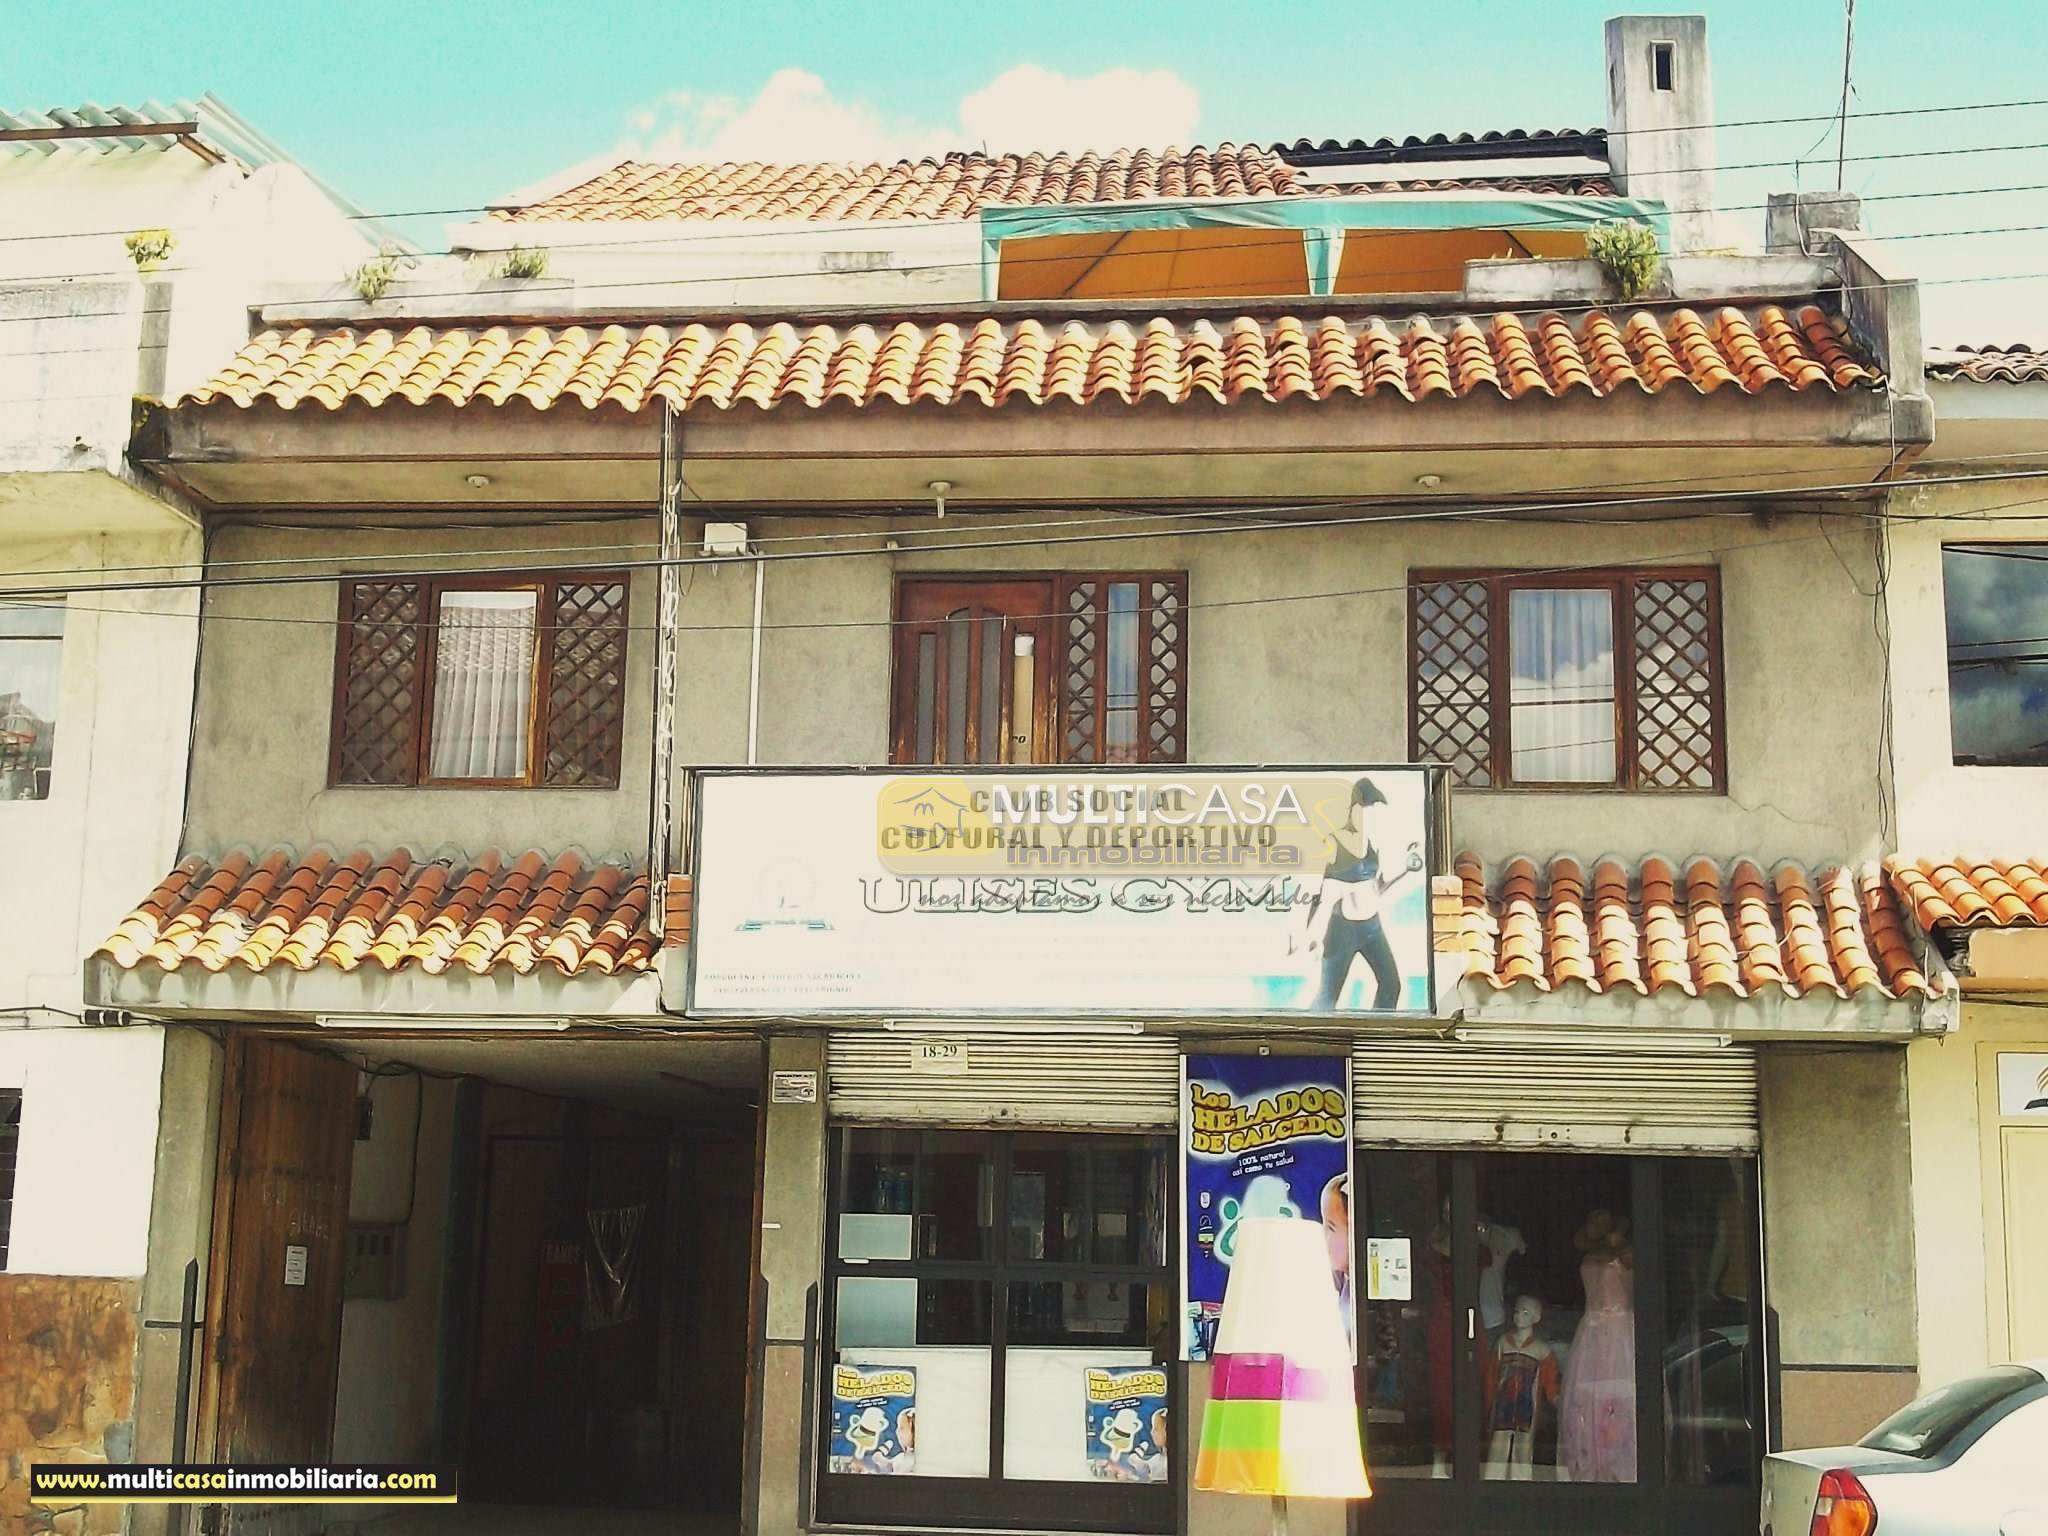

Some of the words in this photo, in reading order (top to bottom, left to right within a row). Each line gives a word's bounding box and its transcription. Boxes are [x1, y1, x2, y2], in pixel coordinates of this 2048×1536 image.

[969, 790, 1053, 813] CLUB
[1067, 789, 1187, 812] SOCIAL
[880, 826, 1045, 849] CULTURAL
[1057, 825, 1074, 849] Y
[1086, 824, 1277, 849] DEPORTIVO
[858, 876, 1100, 914] ULISES
[1110, 875, 1292, 914] GYM
[922, 1045, 958, 1058] 18-29
[1192, 1086, 1347, 1133] HELADOS
[1192, 1130, 1226, 1154] DE
[1228, 1114, 1346, 1153] SALCEDO
